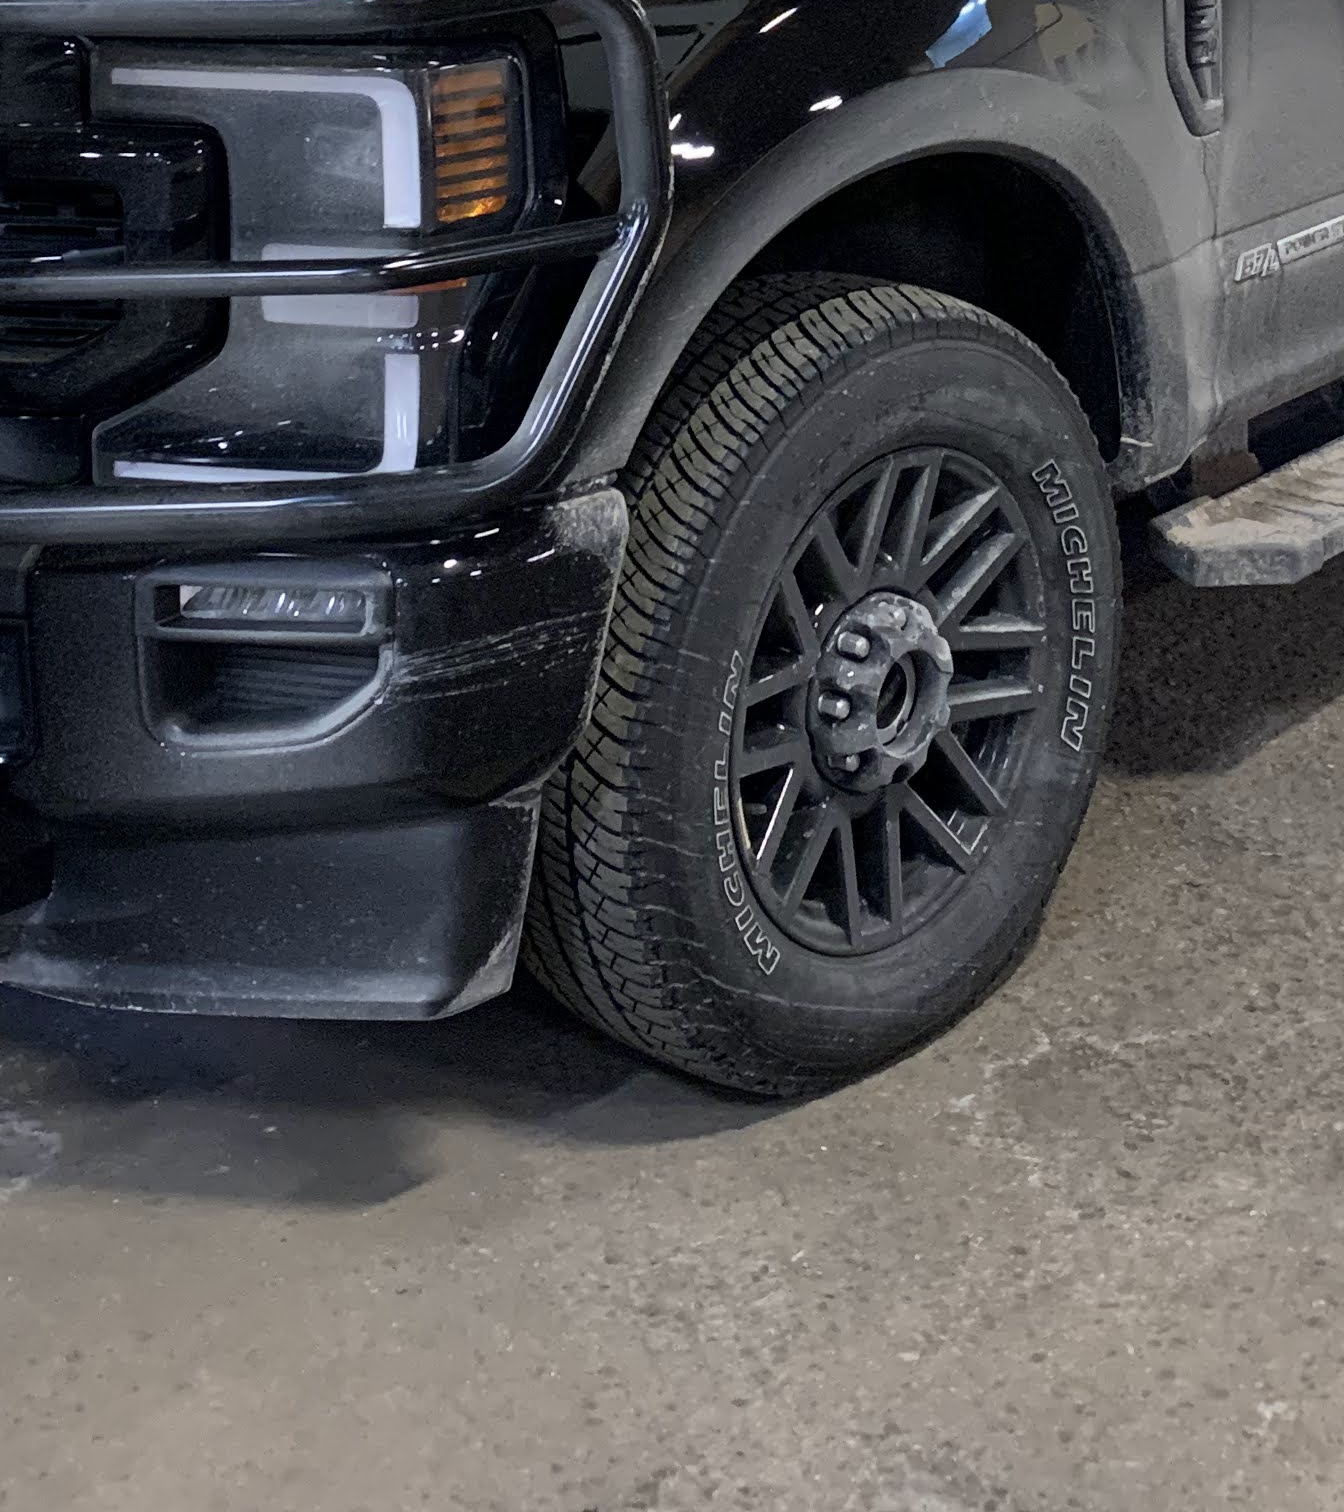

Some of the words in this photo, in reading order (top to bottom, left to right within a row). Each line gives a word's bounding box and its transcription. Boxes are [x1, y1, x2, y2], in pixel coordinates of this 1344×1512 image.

[1282, 226, 1330, 255] POWER
[1031, 458, 1096, 753] MICHELIN
[714, 650, 781, 975] MICHELIN
